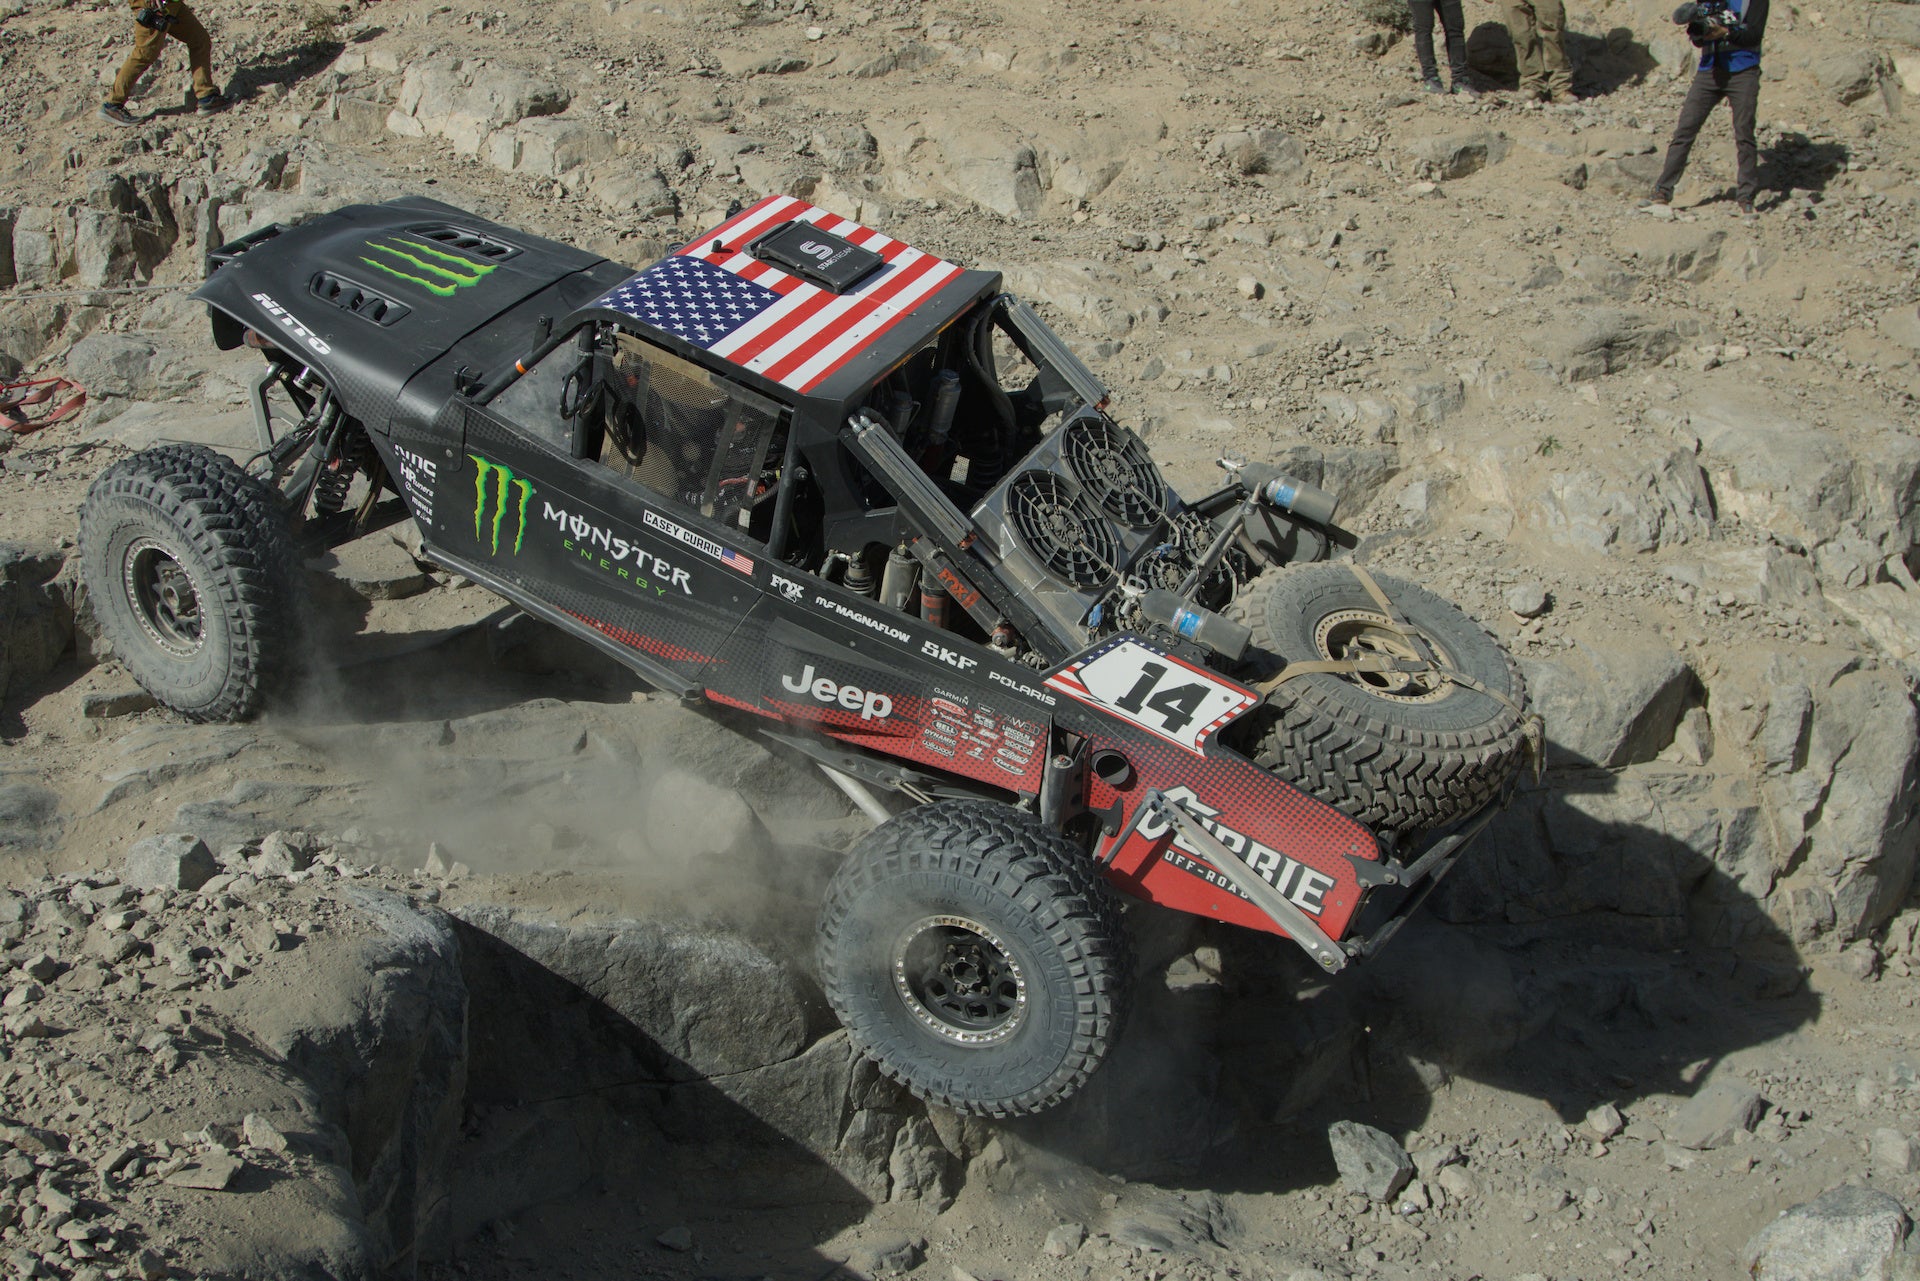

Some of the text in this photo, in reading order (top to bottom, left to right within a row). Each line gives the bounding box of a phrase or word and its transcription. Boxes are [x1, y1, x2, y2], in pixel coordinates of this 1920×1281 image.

[251, 293, 332, 355] NITTO
[644, 512, 722, 560] CASEY CURRIE
[563, 538, 666, 597] ENERGY
[938, 567, 970, 600] FOX
[770, 573, 805, 602] FOX
[835, 603, 911, 644] MAGNAFLOW
[920, 640, 978, 671] SKF
[781, 664, 893, 721] Jeep
[933, 686, 969, 706] GARMIN
[988, 671, 1057, 707] POLARIS
[1113, 661, 1212, 734] 14
[924, 728, 957, 746] DYNAMIC
[935, 721, 956, 735] BELL
[1001, 724, 1031, 741] LINCOLN
